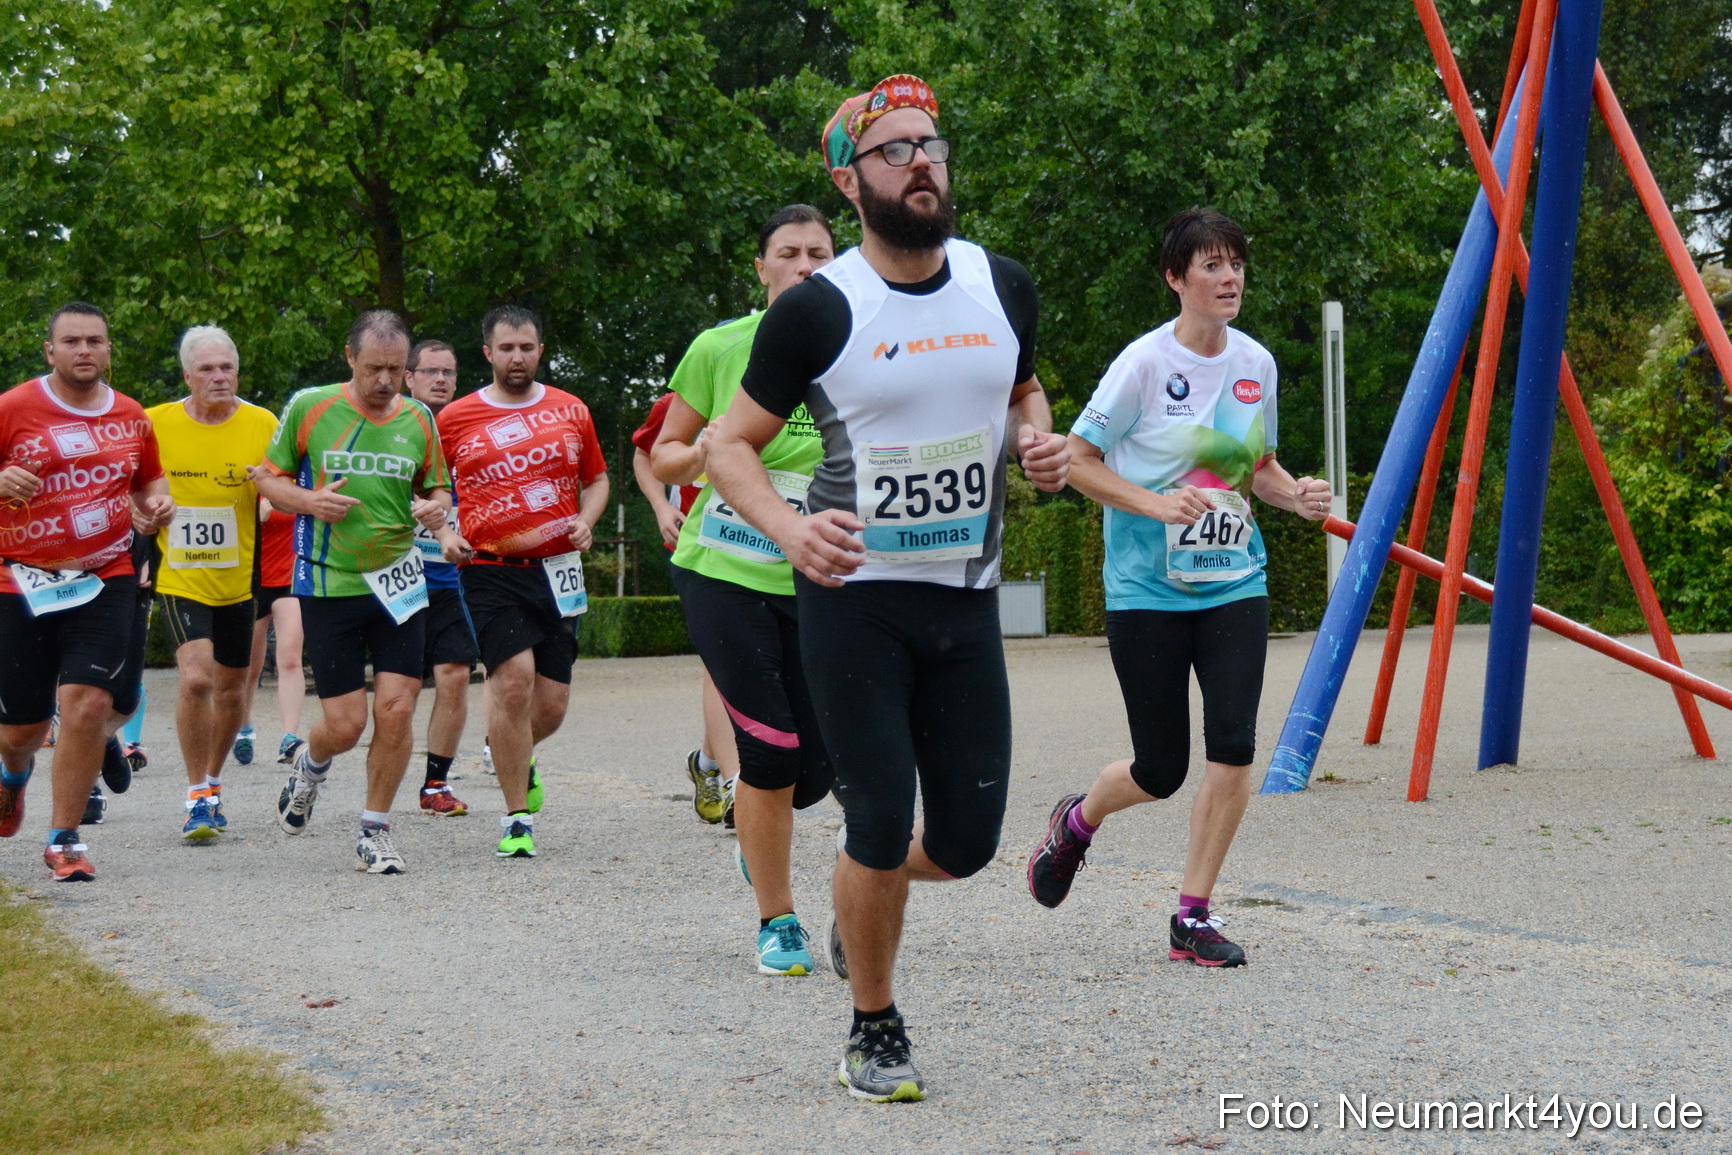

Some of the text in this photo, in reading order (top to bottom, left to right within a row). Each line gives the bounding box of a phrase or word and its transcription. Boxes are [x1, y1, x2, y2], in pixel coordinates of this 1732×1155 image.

[907, 333, 997, 354] KLEBL
[1236, 385, 1261, 398] Hervis
[1166, 404, 1194, 412] PARTL
[920, 434, 983, 461] BOCK
[323, 450, 416, 481] BOCK
[868, 457, 912, 466] NeuerMarkt
[170, 470, 208, 478] Norbert
[874, 461, 986, 519] 2539
[865, 516, 870, 524] C
[1178, 511, 1245, 546] 2467
[181, 522, 225, 546] 130
[896, 527, 970, 548] Thomas
[185, 551, 221, 561] Norbert
[1193, 554, 1231, 569] Monika
[377, 554, 425, 598] 2894
[56, 586, 79, 600] Andi
